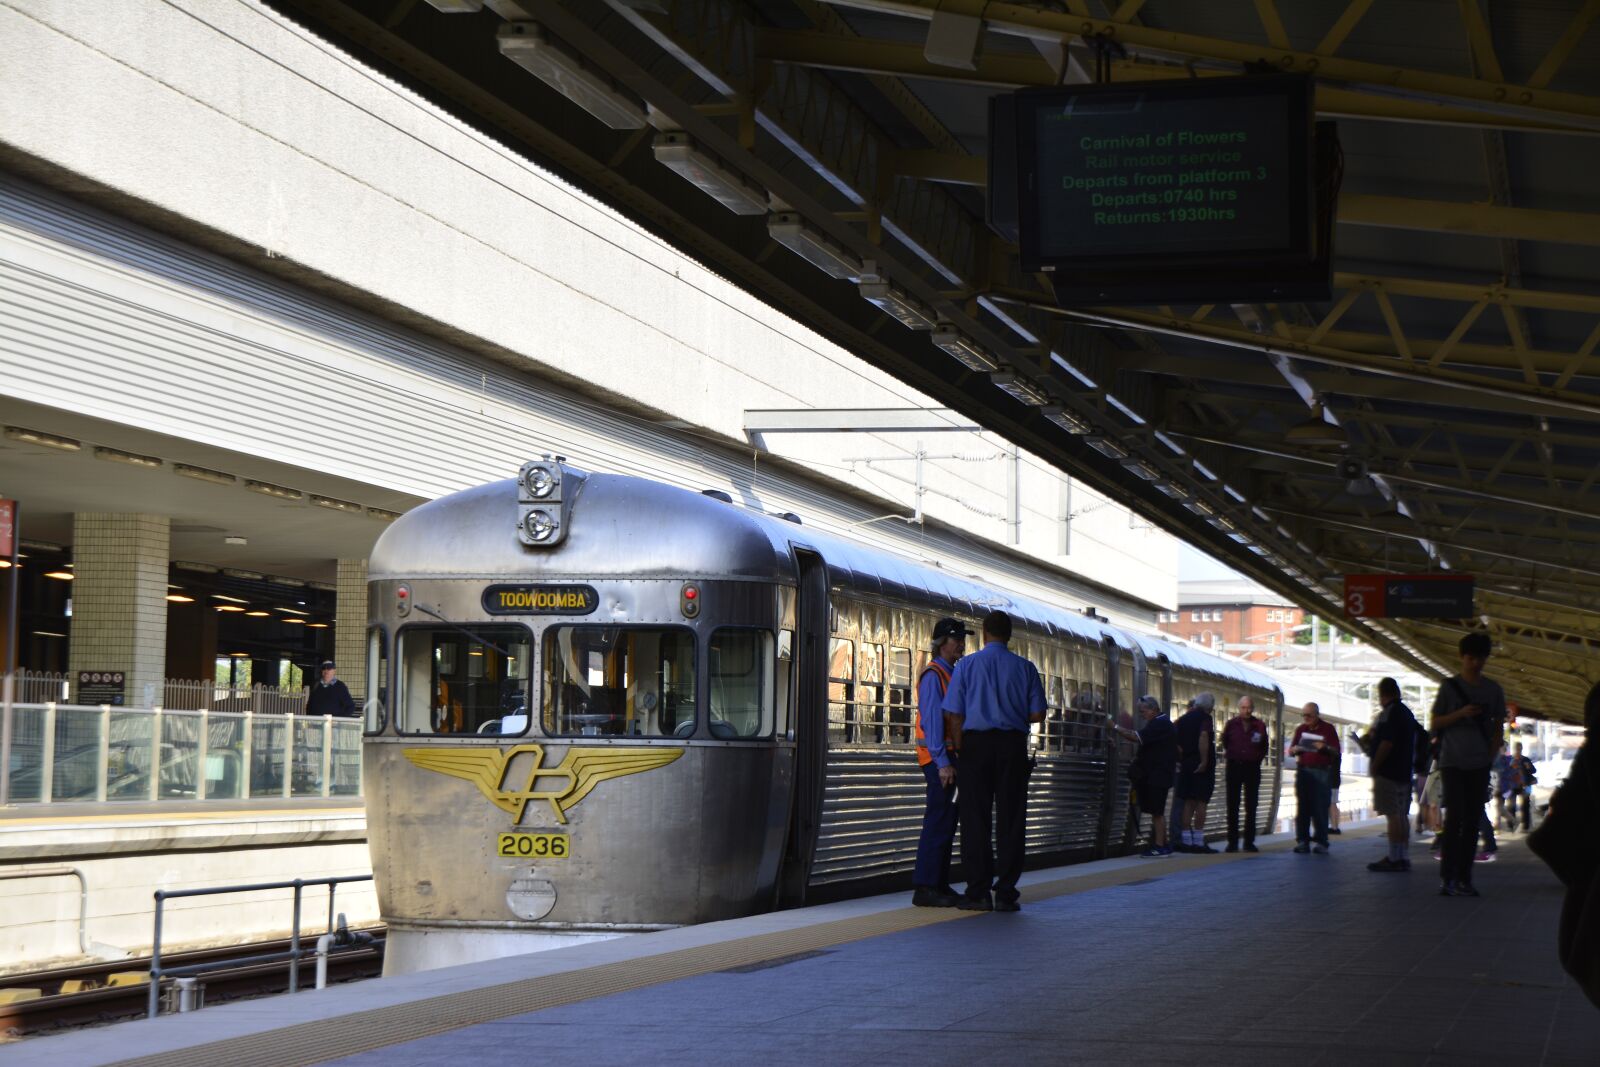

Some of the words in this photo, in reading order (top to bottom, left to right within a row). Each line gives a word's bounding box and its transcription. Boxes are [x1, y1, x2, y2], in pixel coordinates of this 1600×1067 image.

[1080, 134, 1150, 150] Carnival
[1155, 132, 1175, 147] of
[1178, 130, 1247, 146] Flowers
[1086, 155, 1117, 169] Rail
[1123, 153, 1174, 167] motor
[1178, 150, 1242, 165] service
[1062, 175, 1128, 191] Departs
[1133, 172, 1173, 186] from
[1178, 168, 1251, 187] platform
[1256, 166, 1267, 180] 3
[1209, 187, 1237, 201] hrs
[499, 592, 586, 608] TOOWOOMBA
[1347, 592, 1365, 615] 3
[501, 835, 566, 856] 2036
